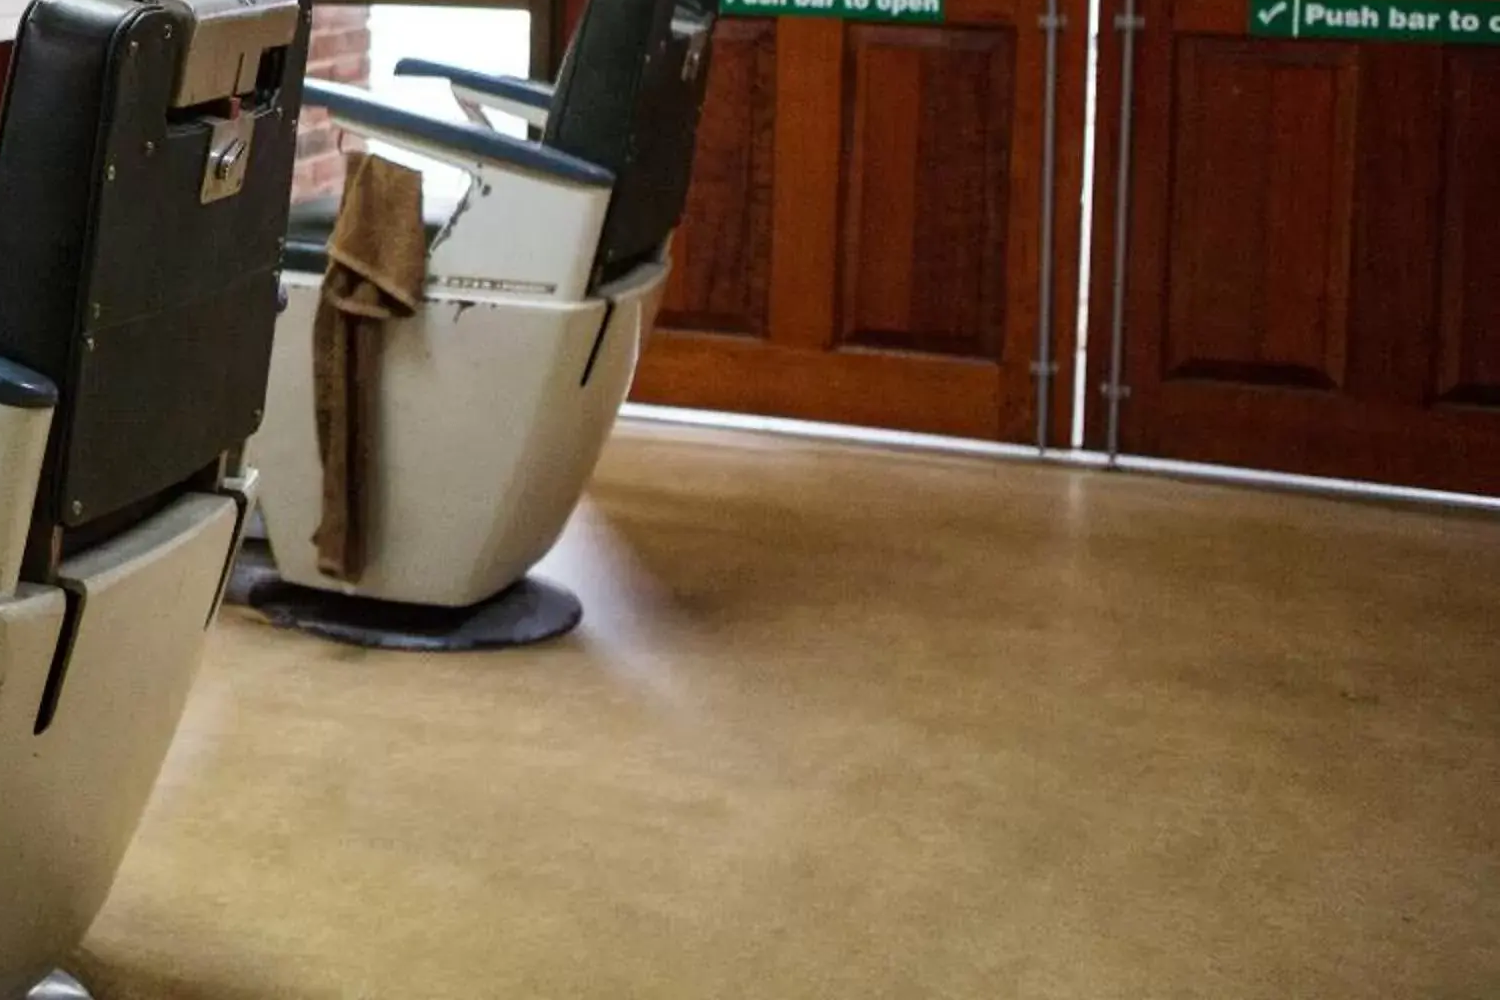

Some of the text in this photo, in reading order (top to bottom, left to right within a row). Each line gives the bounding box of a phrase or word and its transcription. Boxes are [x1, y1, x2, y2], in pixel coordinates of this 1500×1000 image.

[1303, 2, 1379, 29] Push
[1387, 5, 1441, 32] bar
[1449, 9, 1480, 32] to
